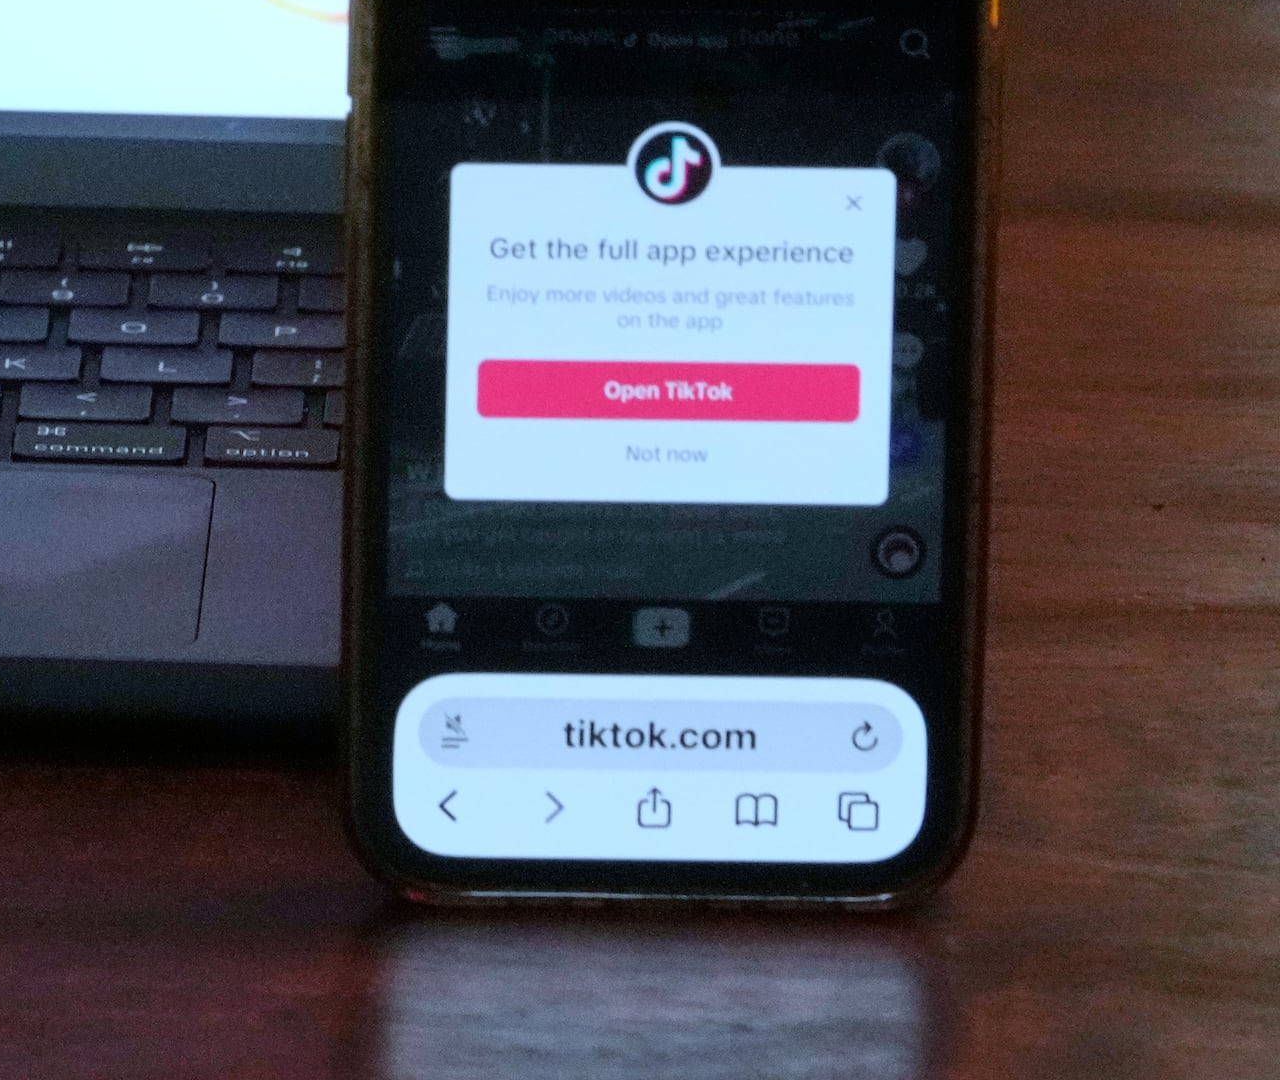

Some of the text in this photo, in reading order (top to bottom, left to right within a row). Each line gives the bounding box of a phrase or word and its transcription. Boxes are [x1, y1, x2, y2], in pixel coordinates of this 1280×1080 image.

[489, 238, 854, 266] Get the full app experience
[486, 285, 855, 308] Enjoy more videos and great features
[275, 325, 299, 337] P
[617, 312, 723, 332] on the app
[5, 358, 26, 370] K
[158, 361, 178, 373] L
[603, 380, 733, 402] Open TikTok
[34, 445, 164, 456] command
[226, 447, 310, 460] option
[625, 445, 708, 464] Not now
[563, 720, 758, 751] tiktok.com
